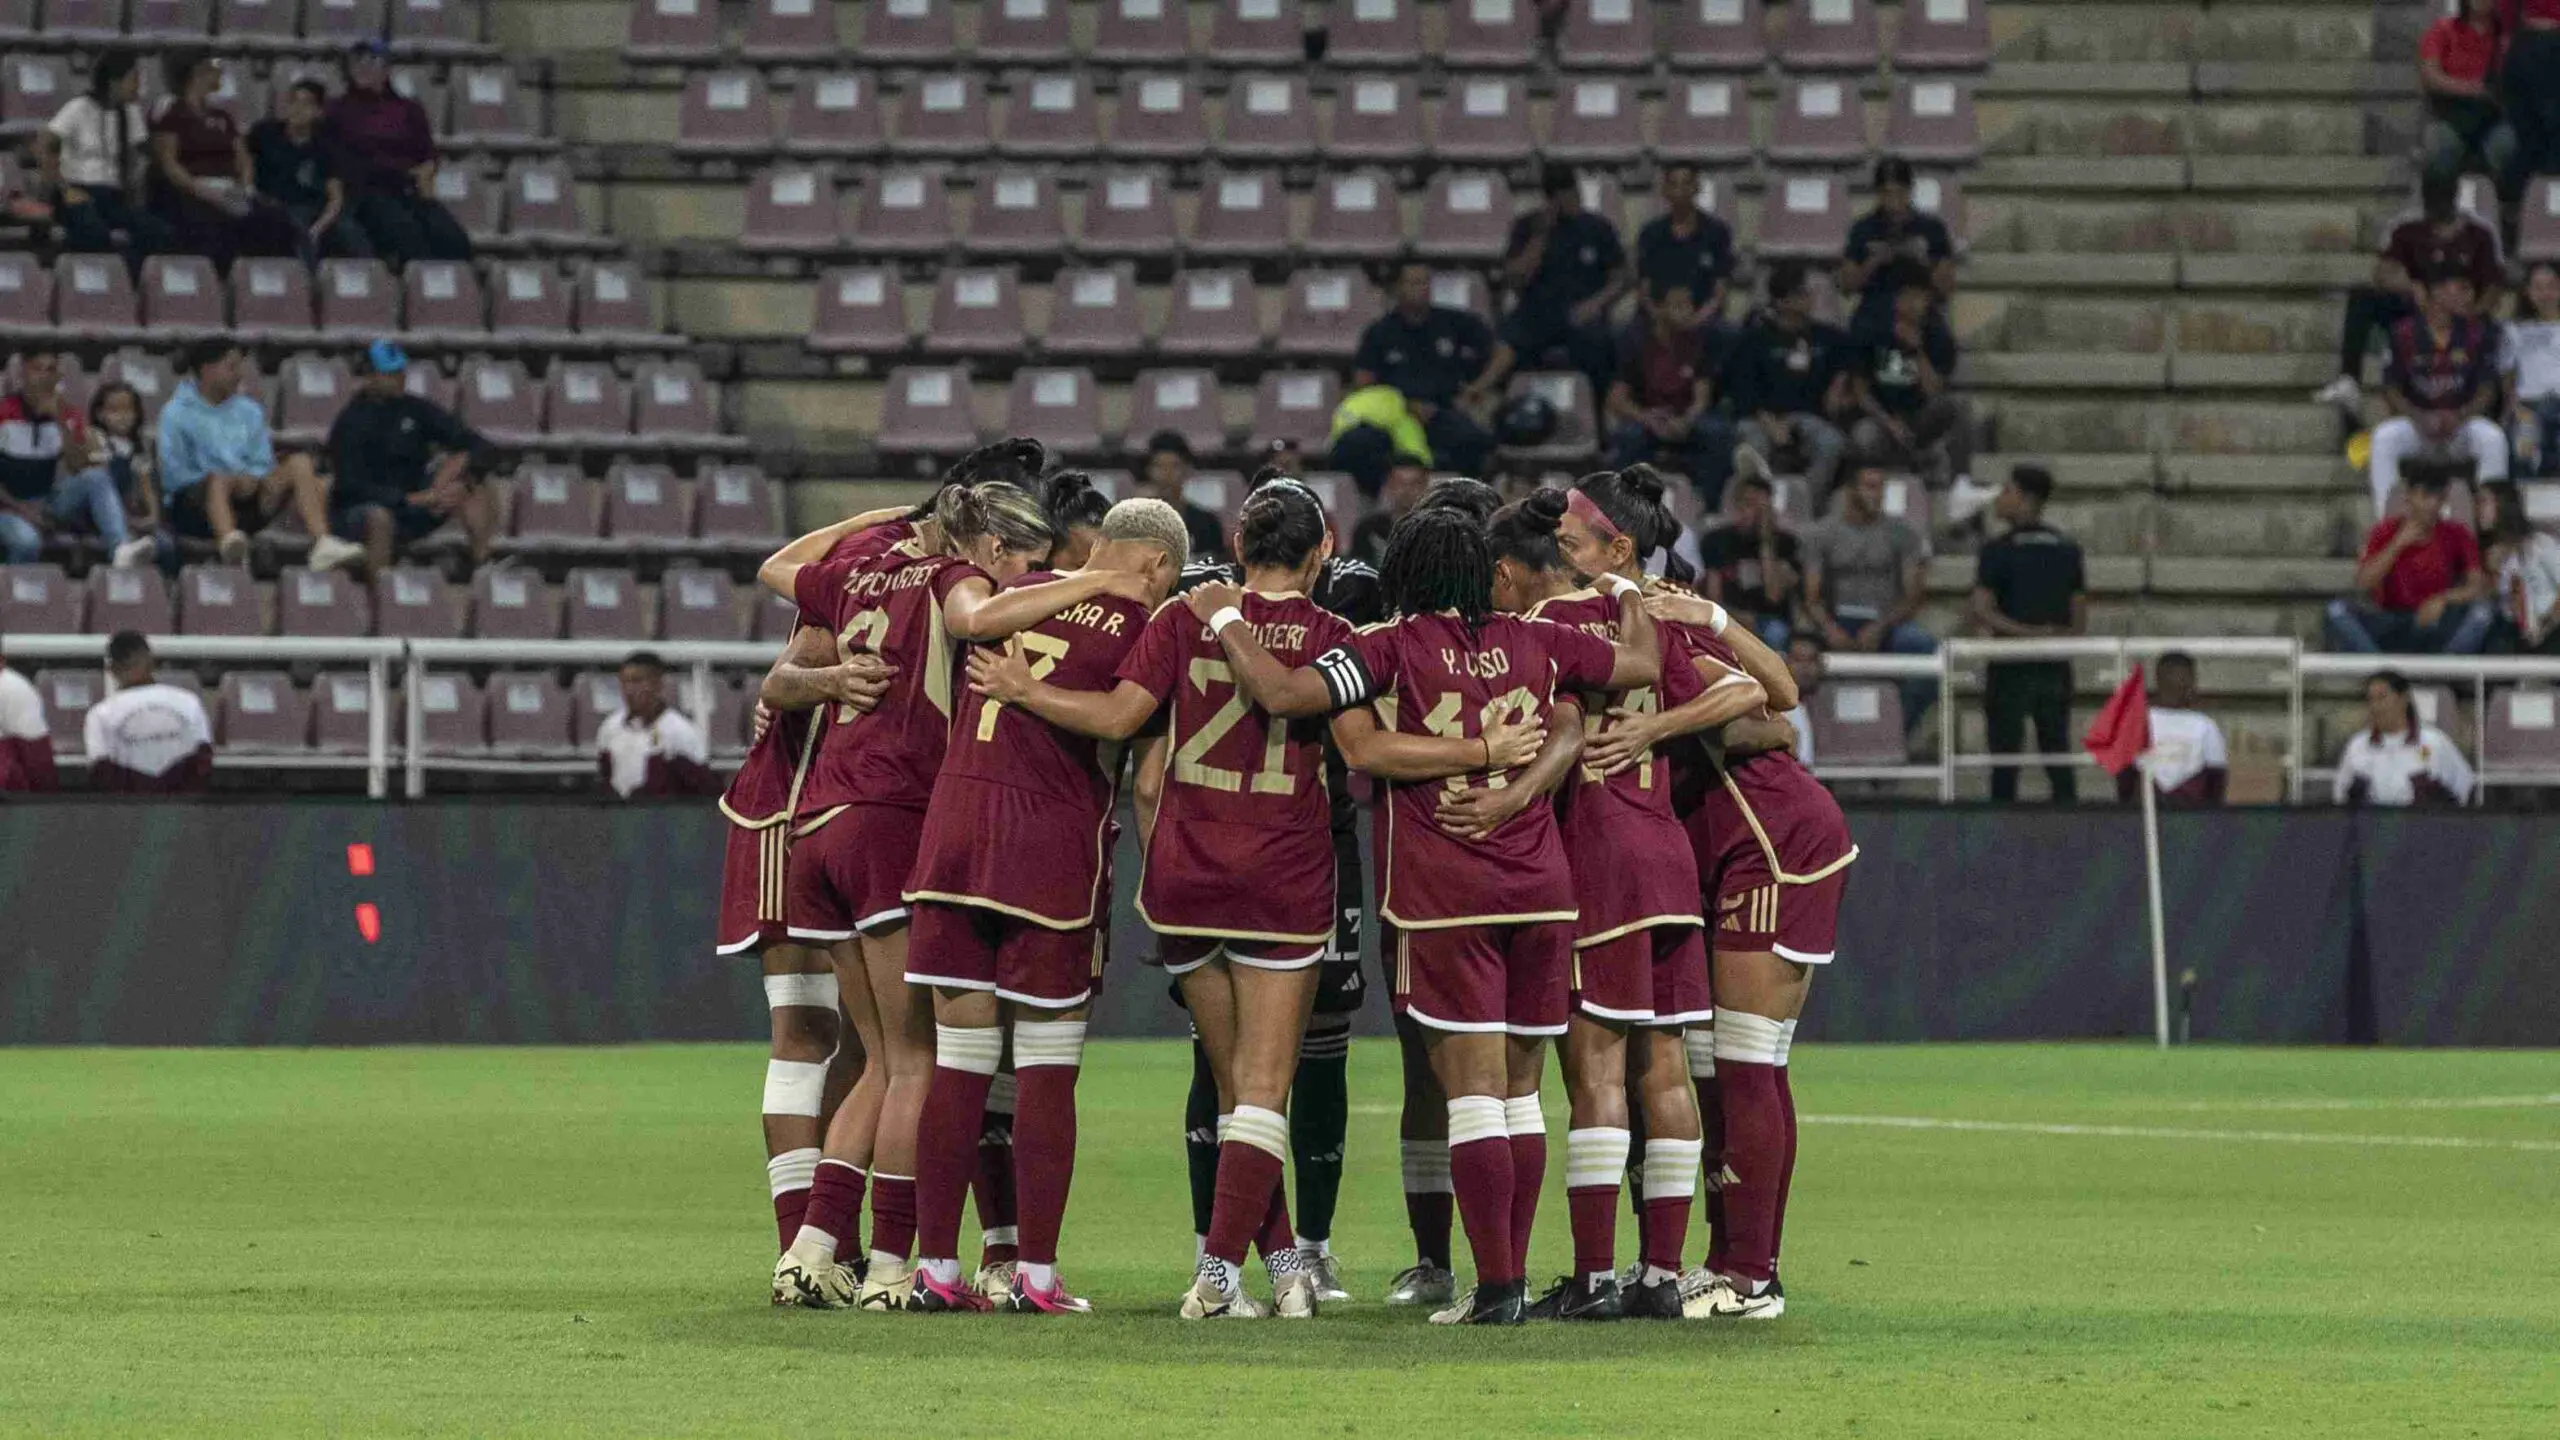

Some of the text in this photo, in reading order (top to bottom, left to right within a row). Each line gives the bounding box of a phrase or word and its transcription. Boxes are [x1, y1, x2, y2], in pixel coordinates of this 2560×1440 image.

[1101, 611, 1125, 637] R.
[1440, 648, 1462, 675] Y.
[1174, 656, 1297, 796] 21
